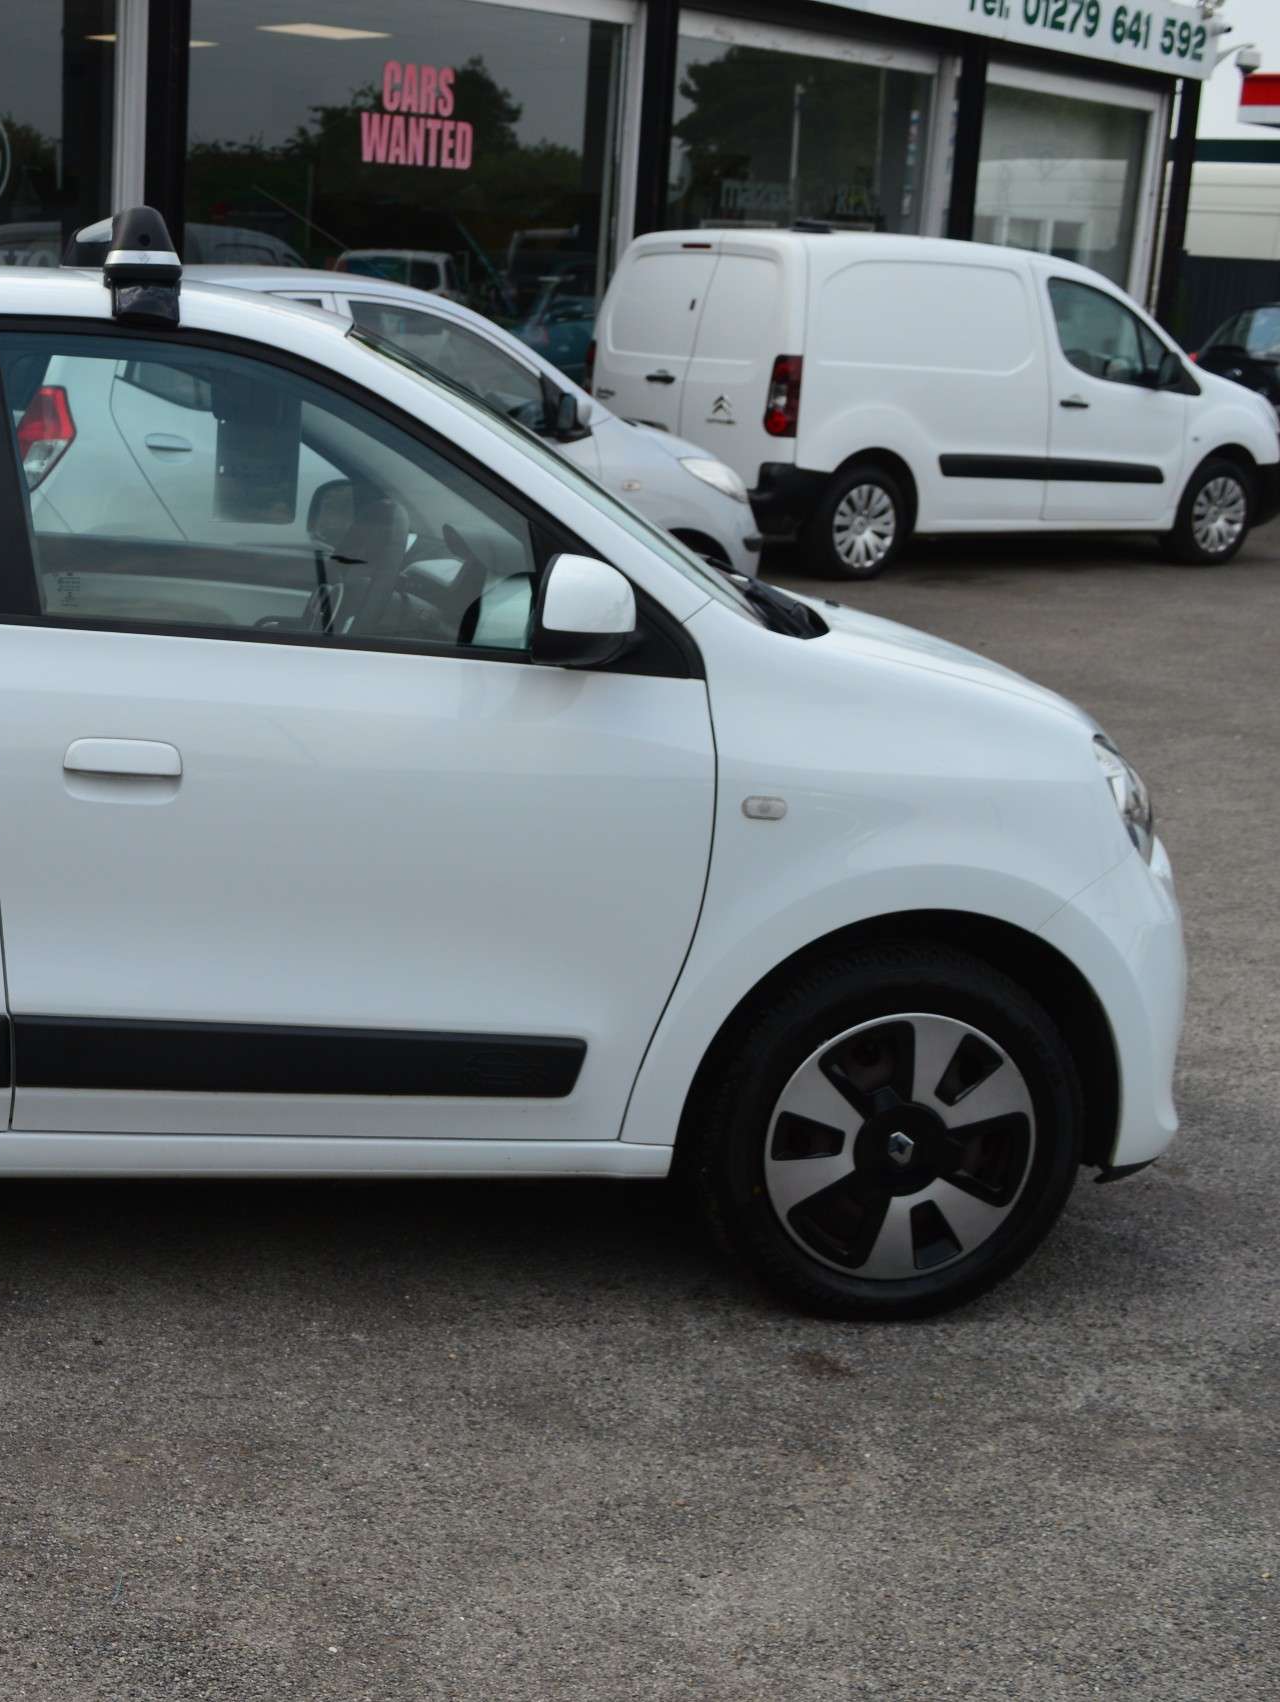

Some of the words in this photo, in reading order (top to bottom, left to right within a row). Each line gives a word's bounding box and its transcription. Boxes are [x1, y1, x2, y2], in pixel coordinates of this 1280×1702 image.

[1022, 0, 1102, 38] 01279
[1111, 5, 1151, 51] 641
[1159, 18, 1207, 62] 592
[382, 60, 456, 117] CARS
[360, 112, 473, 170] WANTED
